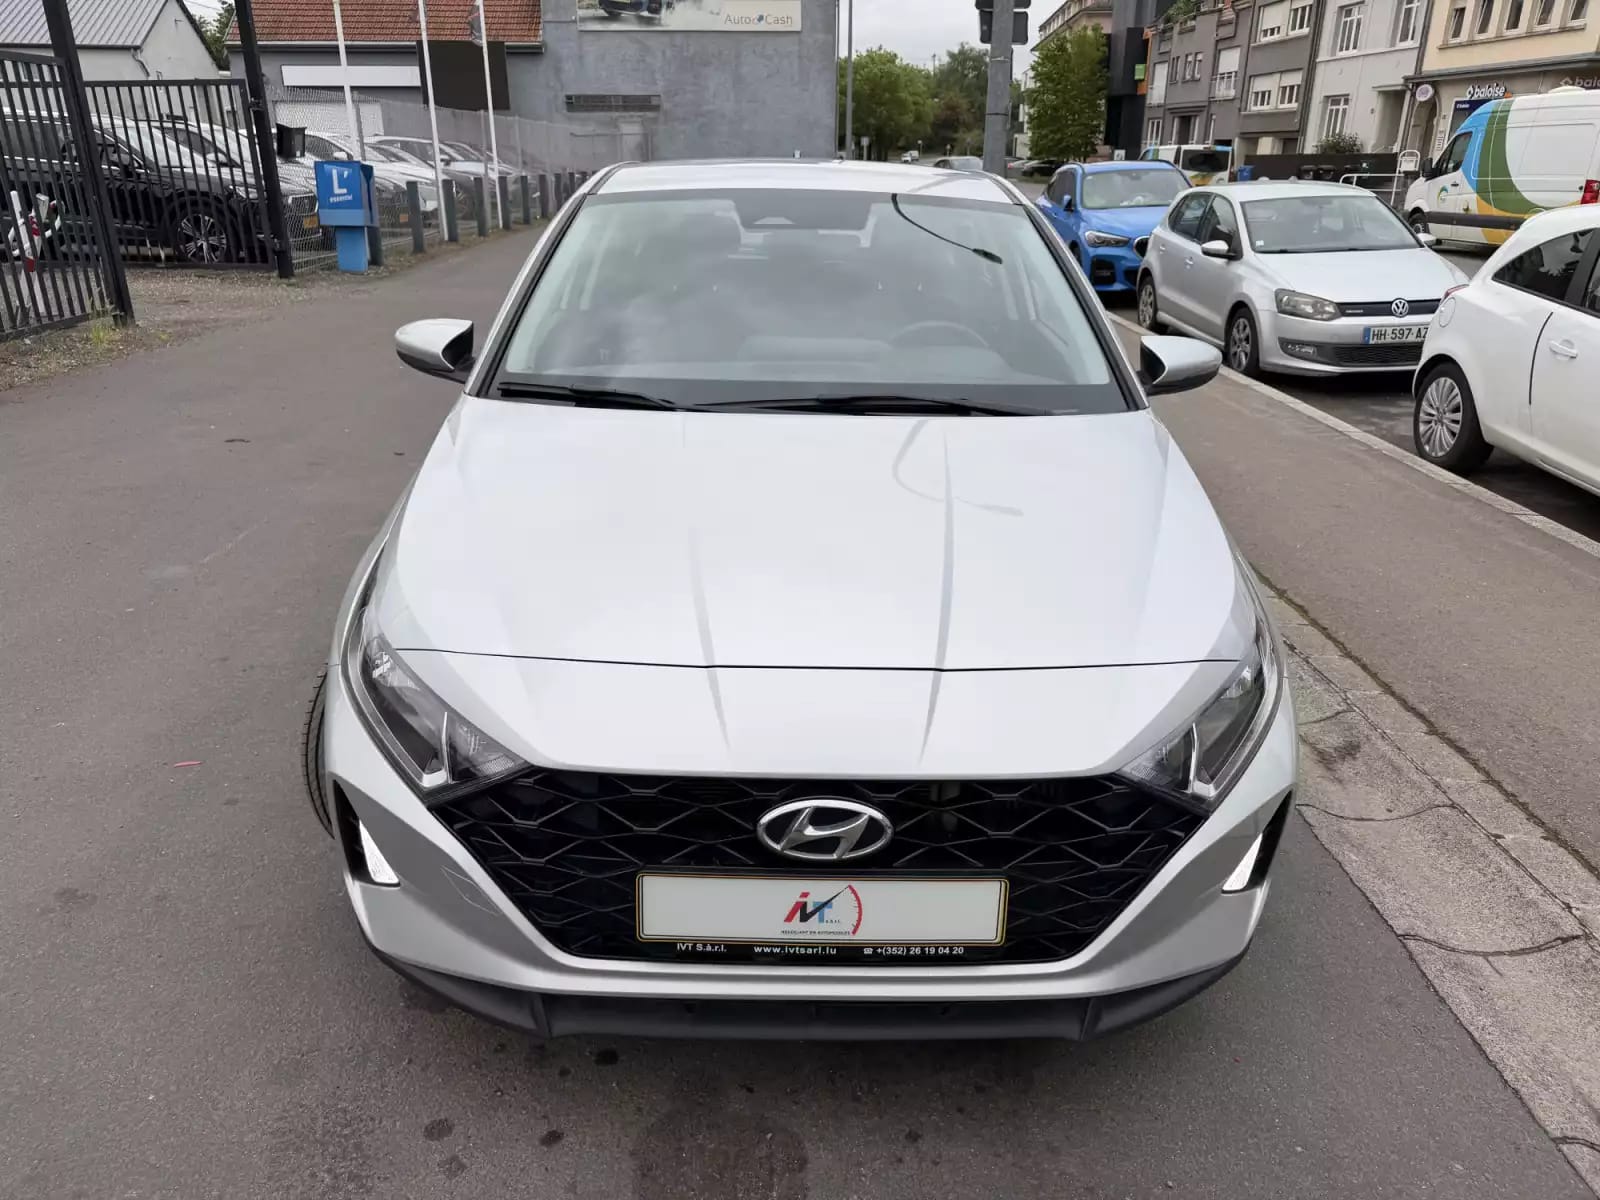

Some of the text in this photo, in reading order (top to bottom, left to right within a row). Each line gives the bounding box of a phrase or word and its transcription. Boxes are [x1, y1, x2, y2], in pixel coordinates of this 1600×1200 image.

[1474, 82, 1506, 98] baloise
[676, 942, 693, 951] IVT
[753, 945, 837, 955] www.ivtsarl.lu
[876, 946, 907, 956] +(352)
[909, 946, 921, 955] 26
[924, 946, 936, 955] 19
[938, 946, 950, 955] 04
[952, 946, 964, 955] 20
